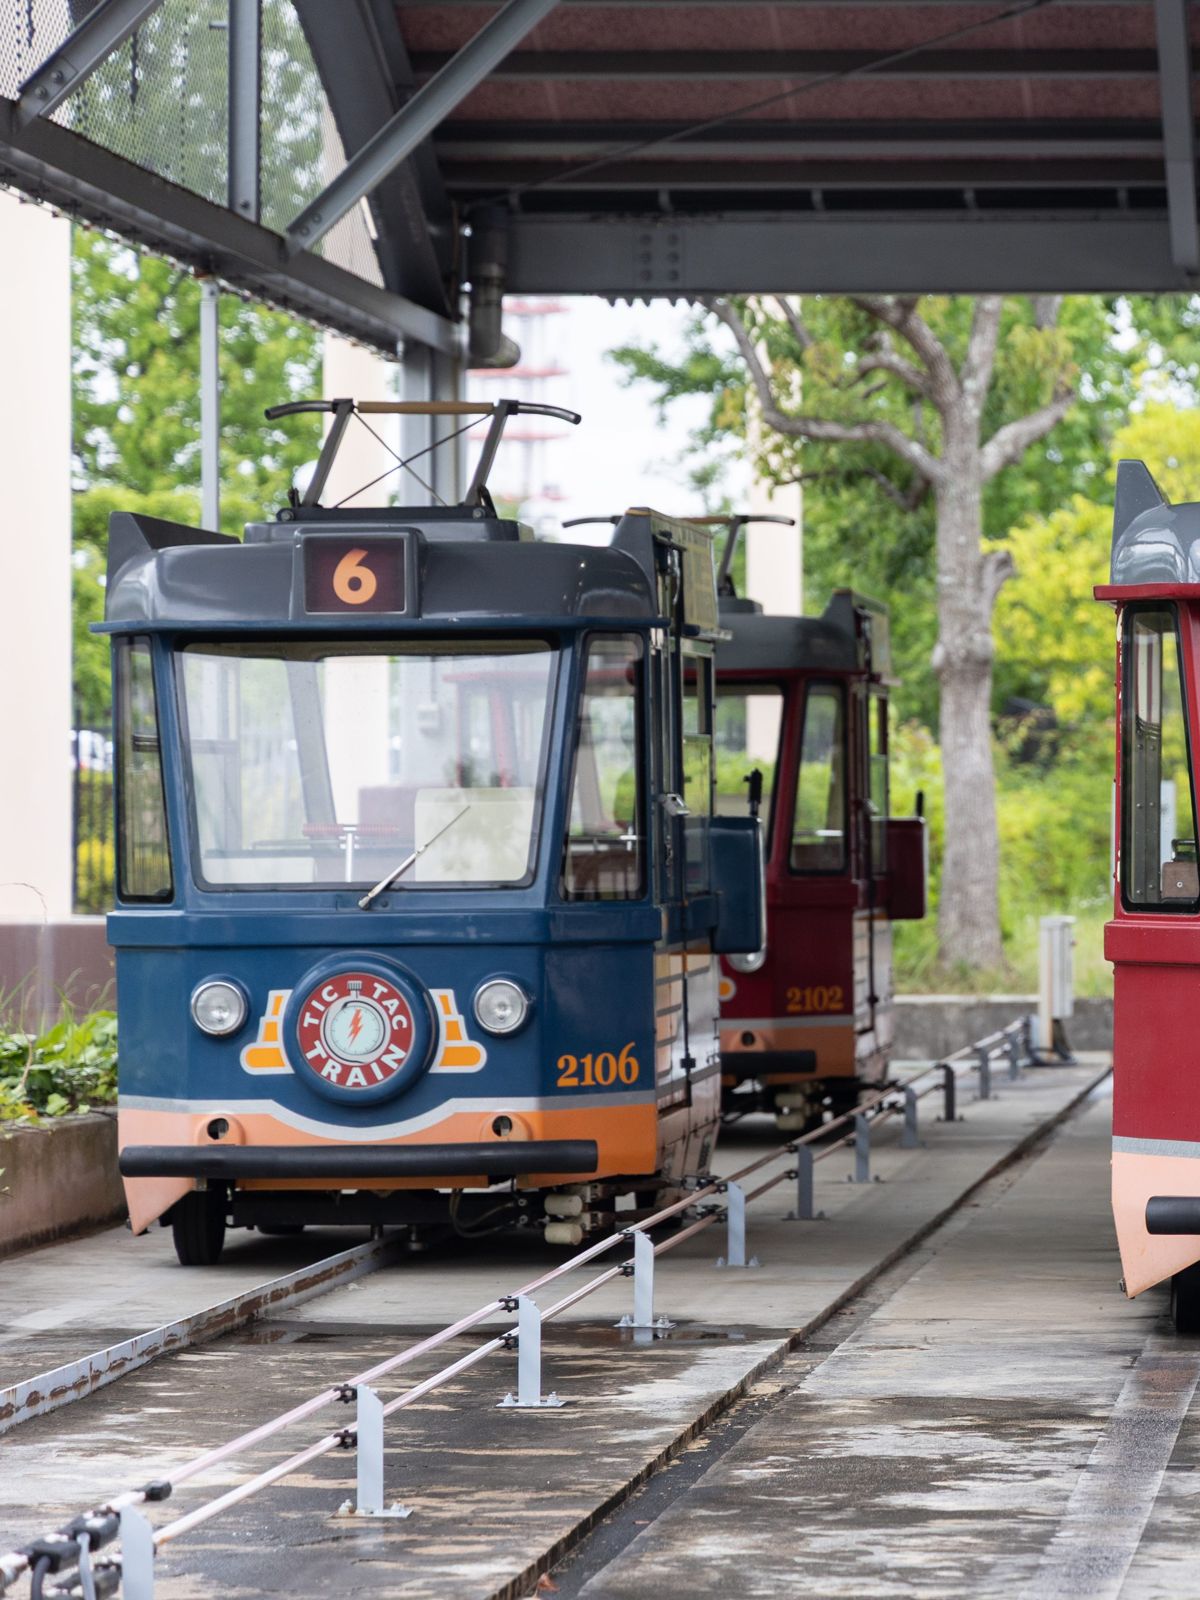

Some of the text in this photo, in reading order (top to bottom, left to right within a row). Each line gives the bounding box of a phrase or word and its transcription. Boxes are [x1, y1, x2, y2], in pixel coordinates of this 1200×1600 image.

[333, 549, 377, 605] 6
[303, 982, 408, 1031] TIC TAC
[786, 986, 845, 1013] 2102
[305, 1040, 407, 1087] TRAIN
[557, 1043, 640, 1088] 2106
